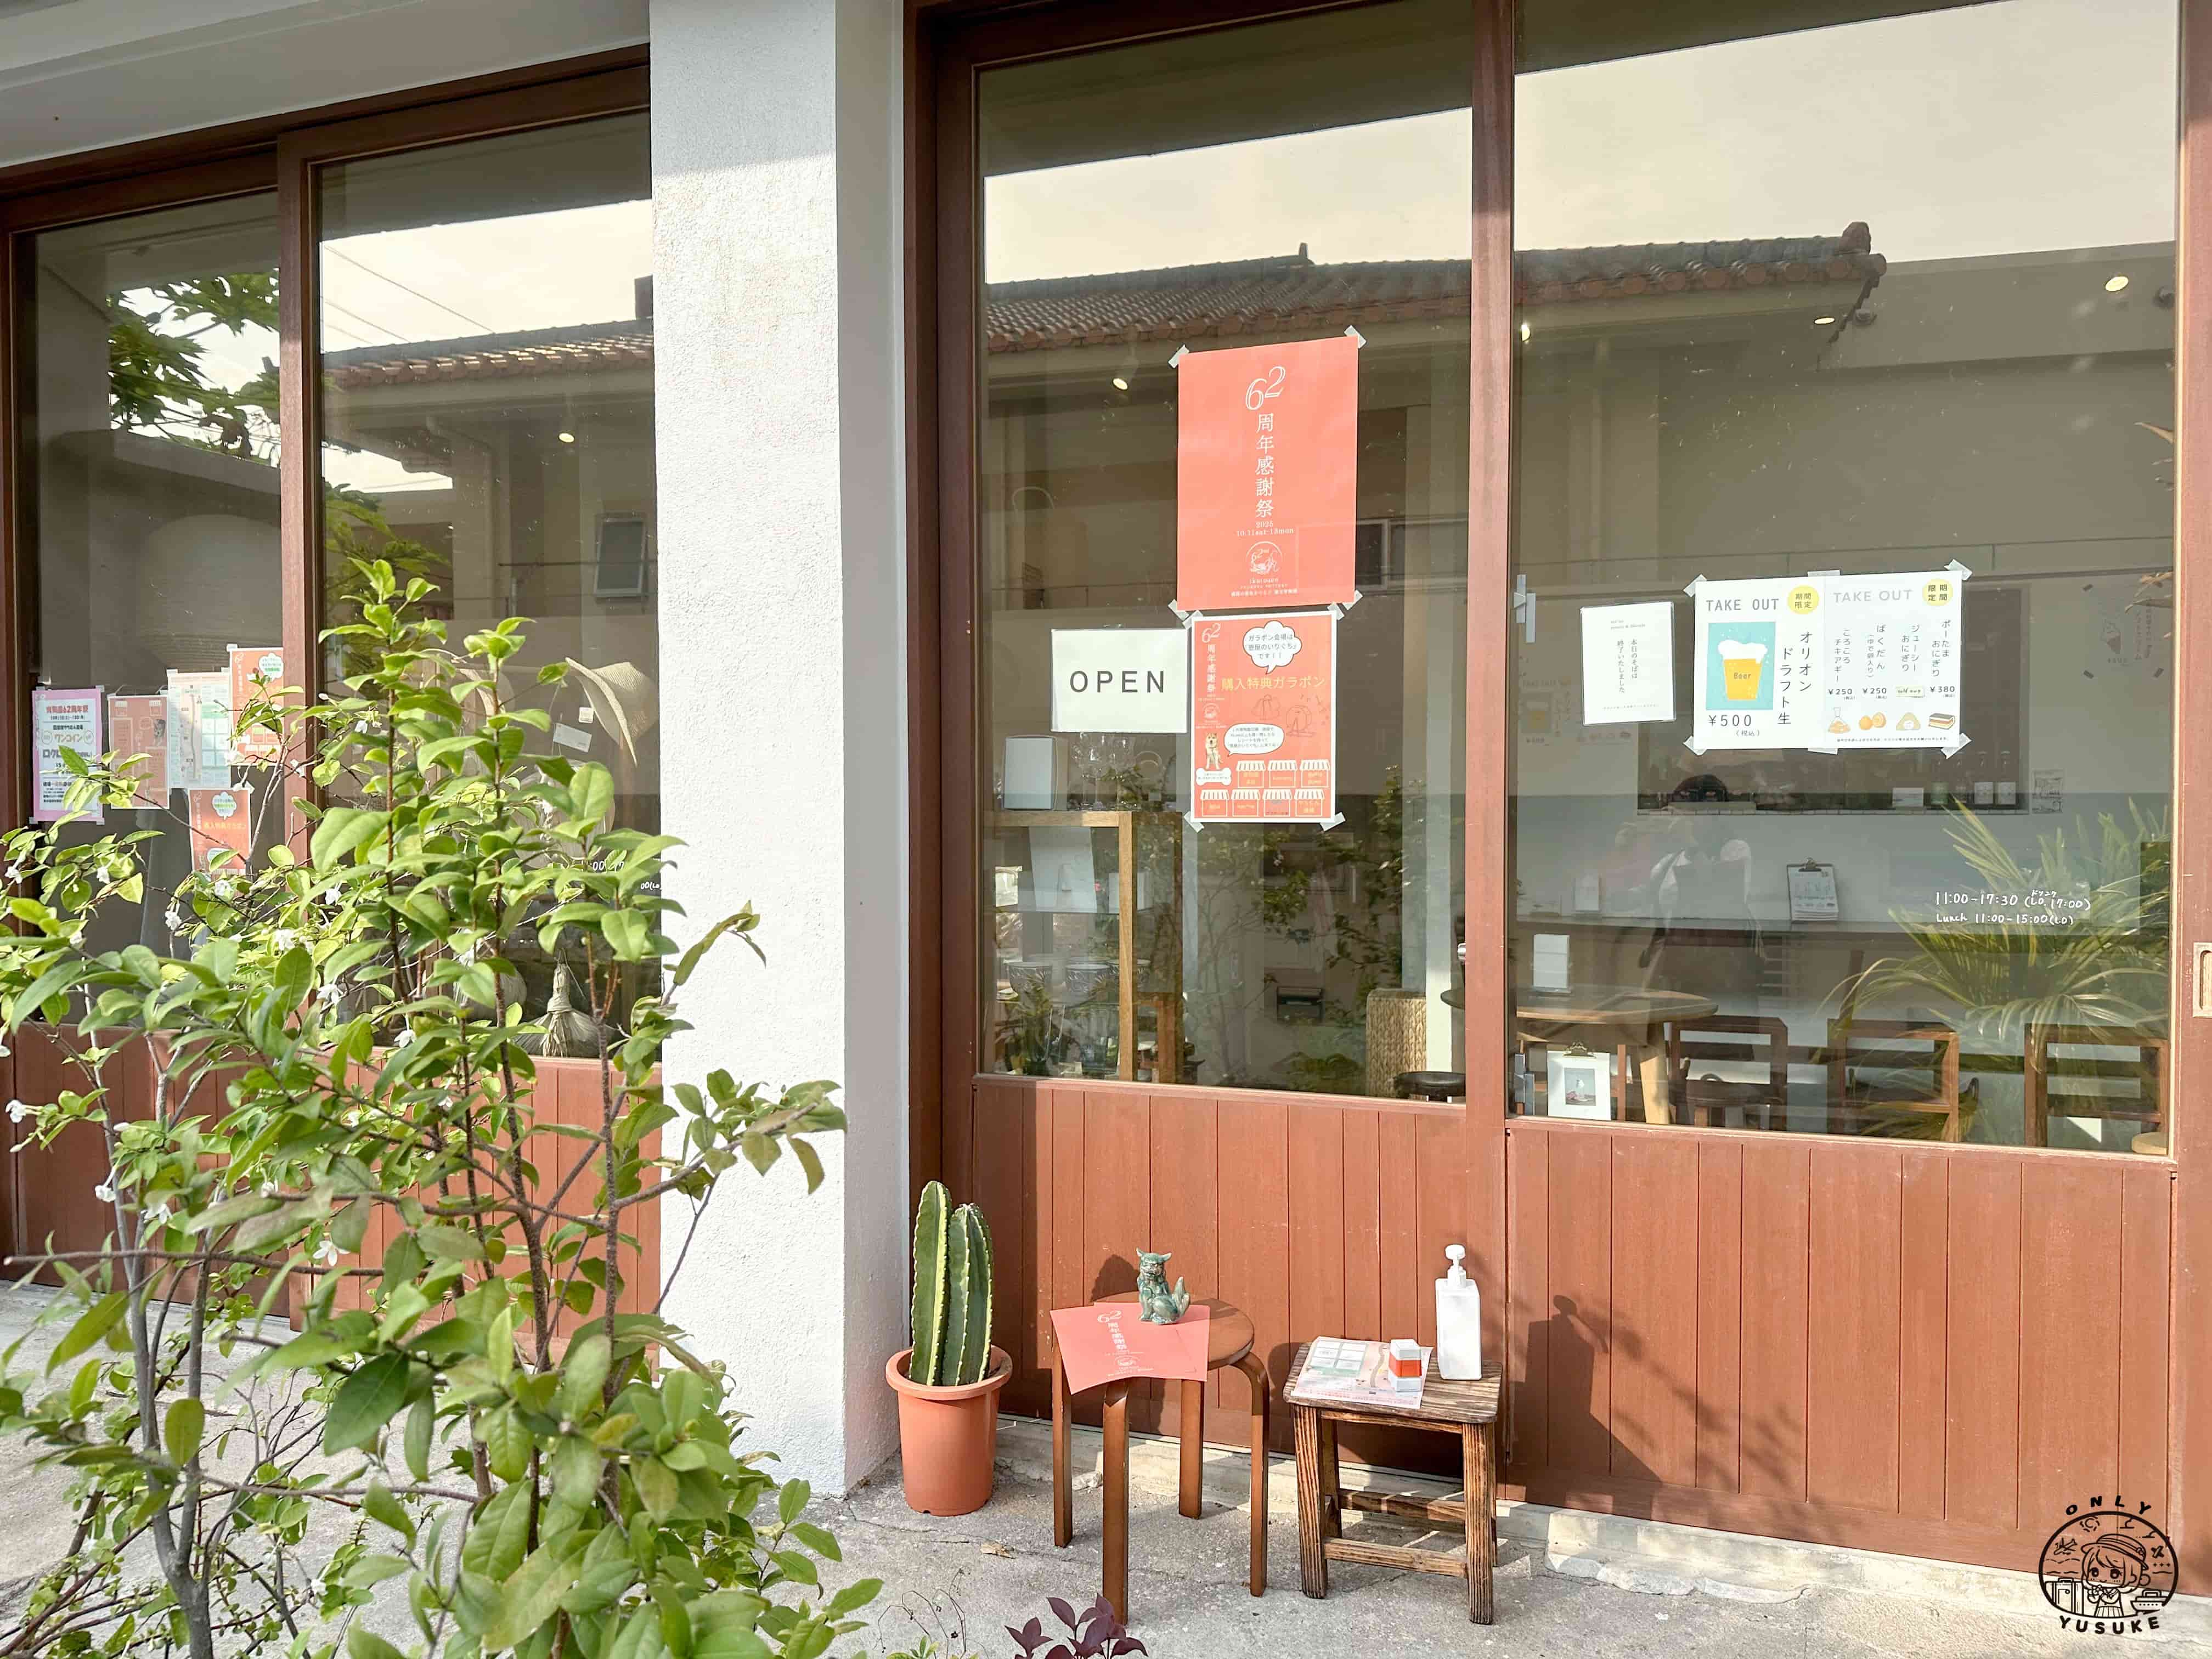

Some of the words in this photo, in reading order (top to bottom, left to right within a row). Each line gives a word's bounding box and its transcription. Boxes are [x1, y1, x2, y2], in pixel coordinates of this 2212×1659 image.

[1245, 366, 1286, 410] 62
[1255, 413, 1274, 518] 周年感謝祭
[1706, 599, 1741, 612] TAKE
[1752, 598, 1779, 611] OUT
[1833, 591, 1872, 603] TAKE
[1879, 589, 1913, 601] OUT
[1201, 623, 1221, 643] 62
[1843, 629, 1851, 664] ころころ
[1877, 624, 1886, 670] ばくだん
[1911, 624, 1920, 673] ジューシー
[1942, 619, 1951, 657] ポーたま
[1799, 631, 1813, 692] オリオン
[1901, 634, 1910, 672] おにぎり
[1932, 640, 1941, 677] おにぎり
[1070, 670, 1164, 693] OPEN
[1777, 647, 1793, 725] ドラフト生
[1708, 714, 1752, 727] ¥500
[1936, 891, 2018, 905] 11:00-17:30
[1937, 912, 1968, 922] Lunch
